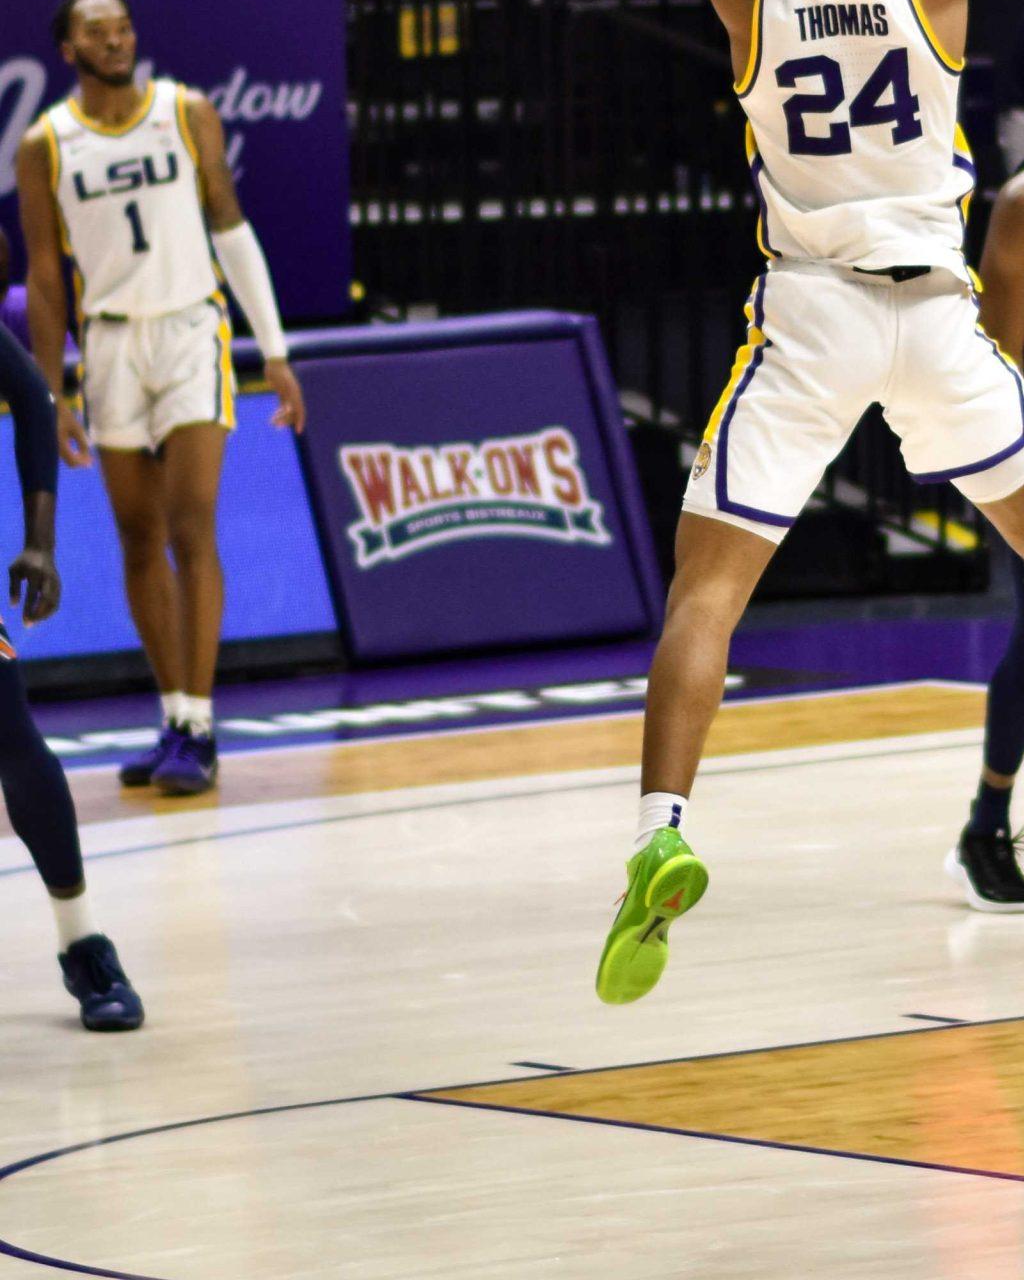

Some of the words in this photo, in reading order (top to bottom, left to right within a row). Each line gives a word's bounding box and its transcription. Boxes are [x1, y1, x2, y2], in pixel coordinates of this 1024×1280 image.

[794, 3, 889, 42] THOMAS
[774, 47, 923, 156] 24
[73, 151, 178, 202] LSU
[124, 200, 150, 255] 1
